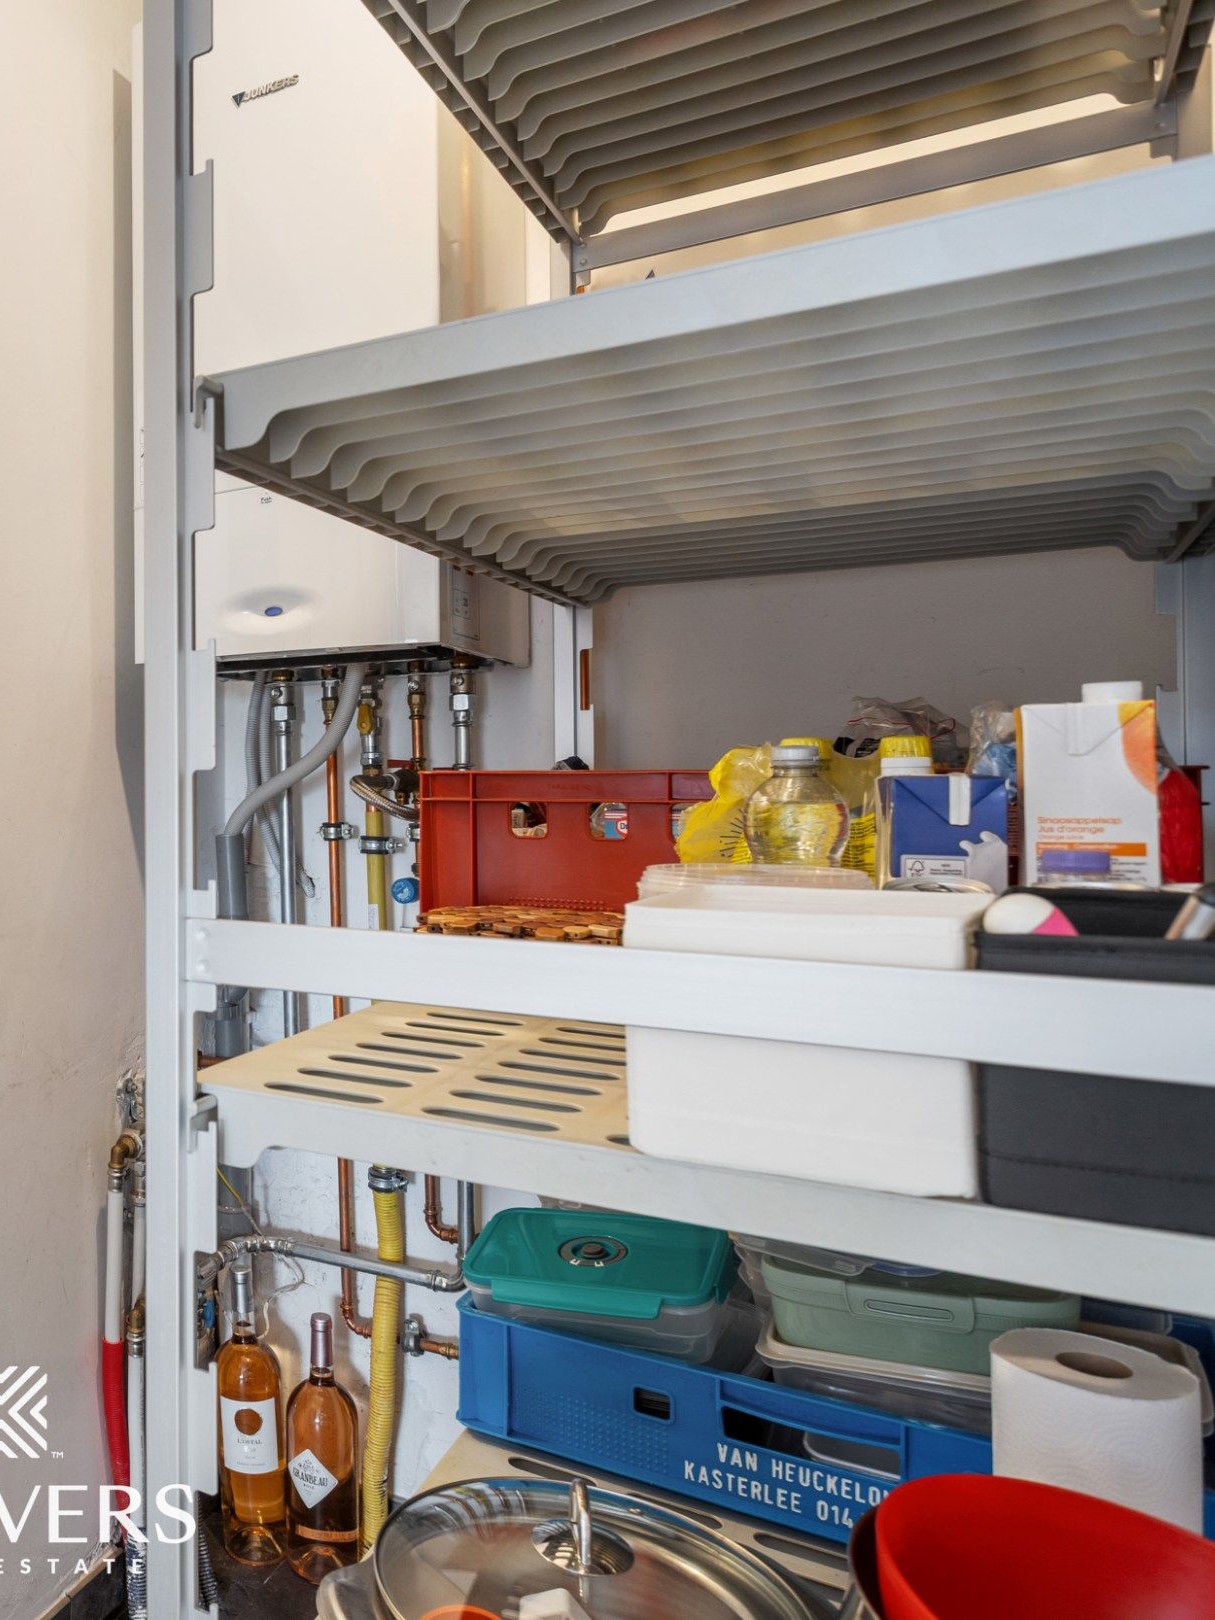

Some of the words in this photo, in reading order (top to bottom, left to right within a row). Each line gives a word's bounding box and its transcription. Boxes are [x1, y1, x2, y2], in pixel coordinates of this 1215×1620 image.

[242, 74, 300, 103] JUNKERS
[717, 1442, 758, 1472] VAN
[292, 1467, 328, 1487] GRANBEAU
[684, 1459, 802, 1514] KASTERLEE
